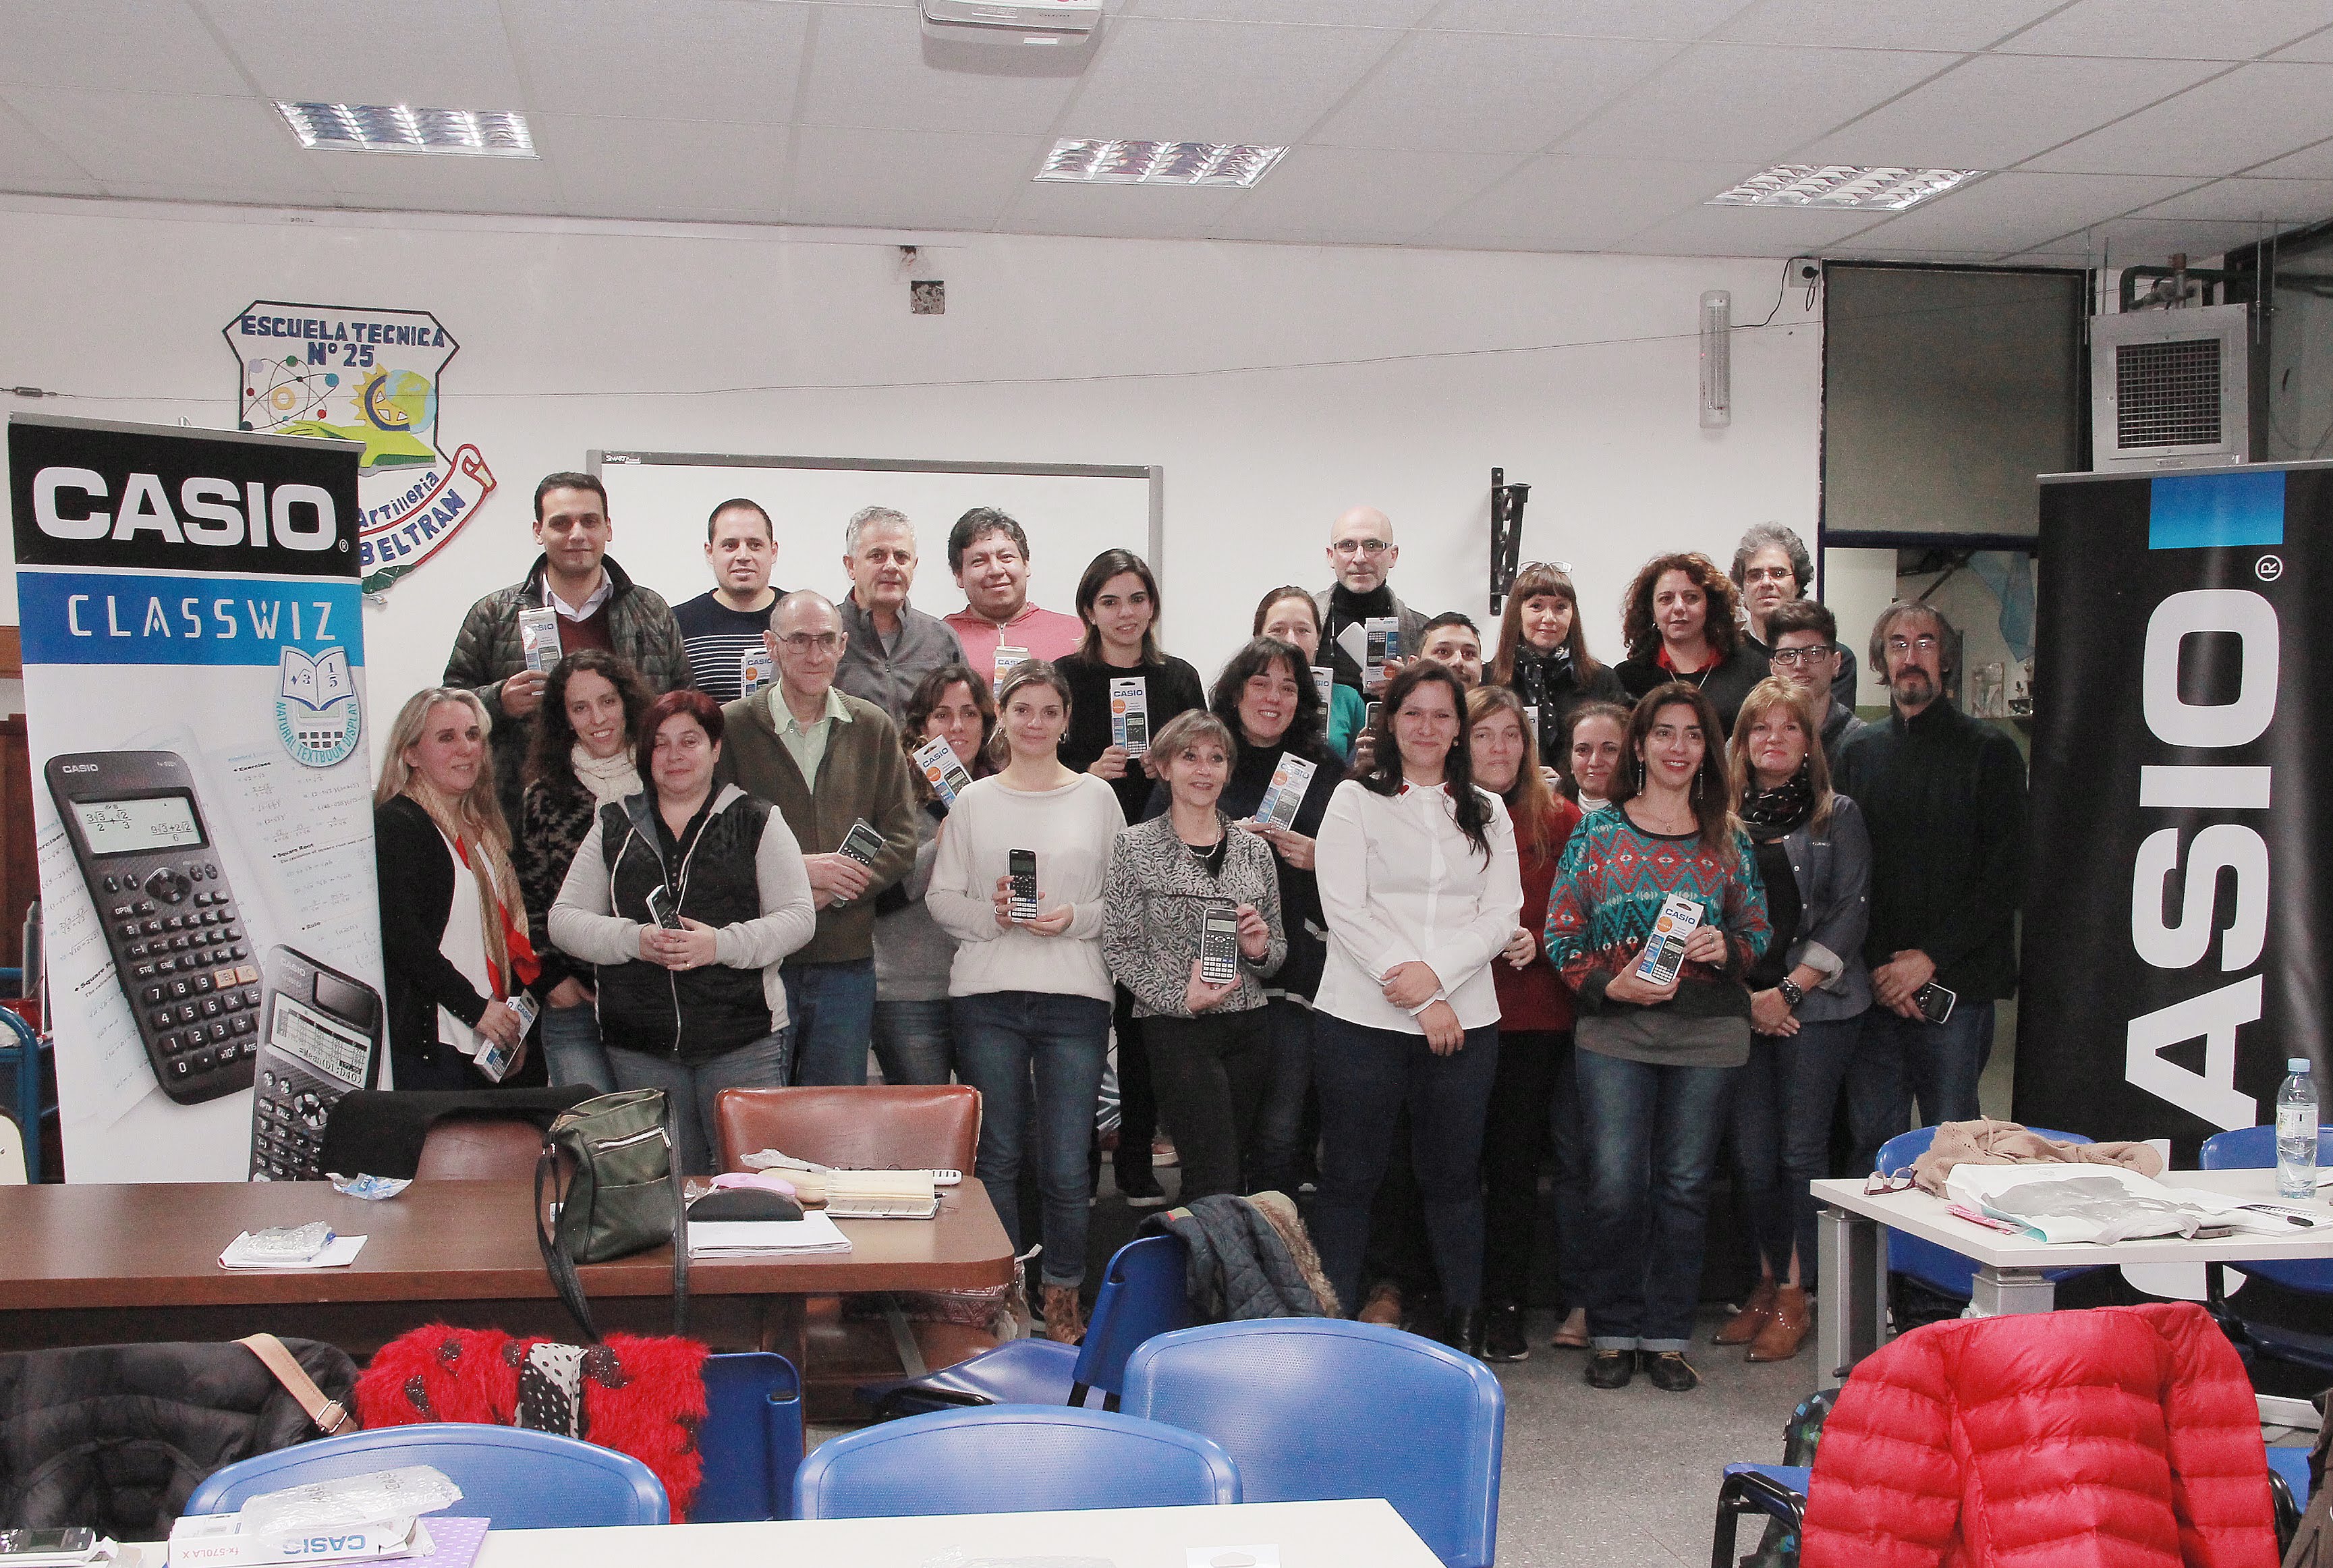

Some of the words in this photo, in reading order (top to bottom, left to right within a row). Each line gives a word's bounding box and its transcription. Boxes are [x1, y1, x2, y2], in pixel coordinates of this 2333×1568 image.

[241, 314, 347, 343] ESCUELA
[351, 321, 445, 348] TECNICA
[343, 343, 375, 368] 25
[360, 488, 466, 566] BELTRAN
[68, 594, 336, 641] CLASSWIZ
[275, 702, 297, 751] NATURAL
[296, 744, 346, 764] TEXTBOOK
[344, 702, 358, 748] DISPLAY
[238, 762, 271, 771] Exercises
[922, 747, 949, 768] CASIO
[62, 764, 99, 773] CASIO
[277, 847, 298, 858] Square
[1665, 908, 1695, 924] CASIO
[139, 965, 152, 974] STO
[161, 961, 173, 970] ENG
[80, 968, 105, 989] Square
[152, 988, 160, 999] 7
[177, 982, 186, 993] 8
[200, 978, 208, 988] 9
[161, 1013, 169, 1024] 4
[186, 1007, 194, 1018] 5
[208, 1001, 217, 1011] 6
[517, 1003, 534, 1023] CASIO
[171, 1038, 177, 1048] 1
[194, 1031, 202, 1042] 2
[217, 1025, 224, 1035] 3
[179, 1062, 186, 1073] 0
[244, 1043, 257, 1053] Ans
[193, 1546, 240, 1558] fx-570LA
